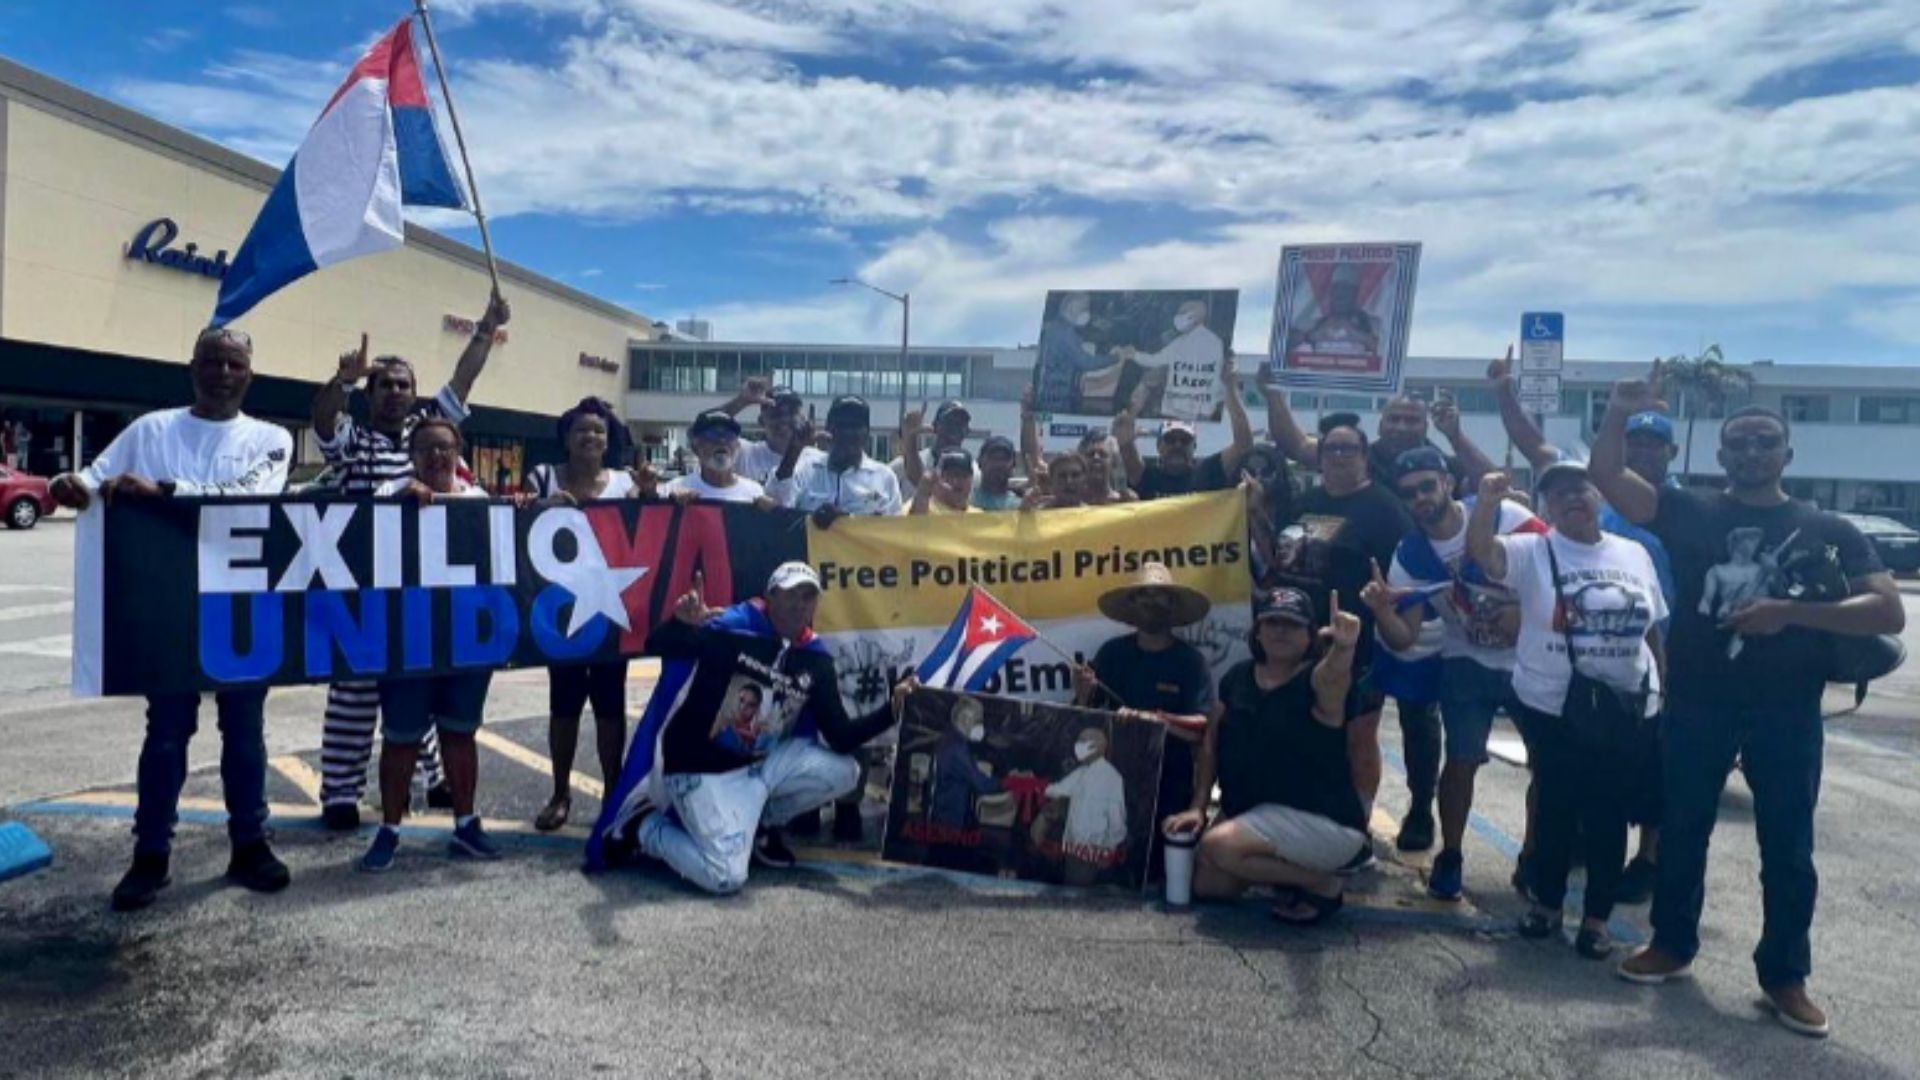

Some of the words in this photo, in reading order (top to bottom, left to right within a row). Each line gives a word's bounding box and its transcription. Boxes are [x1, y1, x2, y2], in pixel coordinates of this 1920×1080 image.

[198, 503, 597, 592] EXILIO
[584, 504, 734, 654] YA
[819, 561, 898, 590] Free
[910, 551, 1062, 586] Political
[1074, 539, 1241, 577] Prisoners
[198, 583, 610, 683] UNIDO
